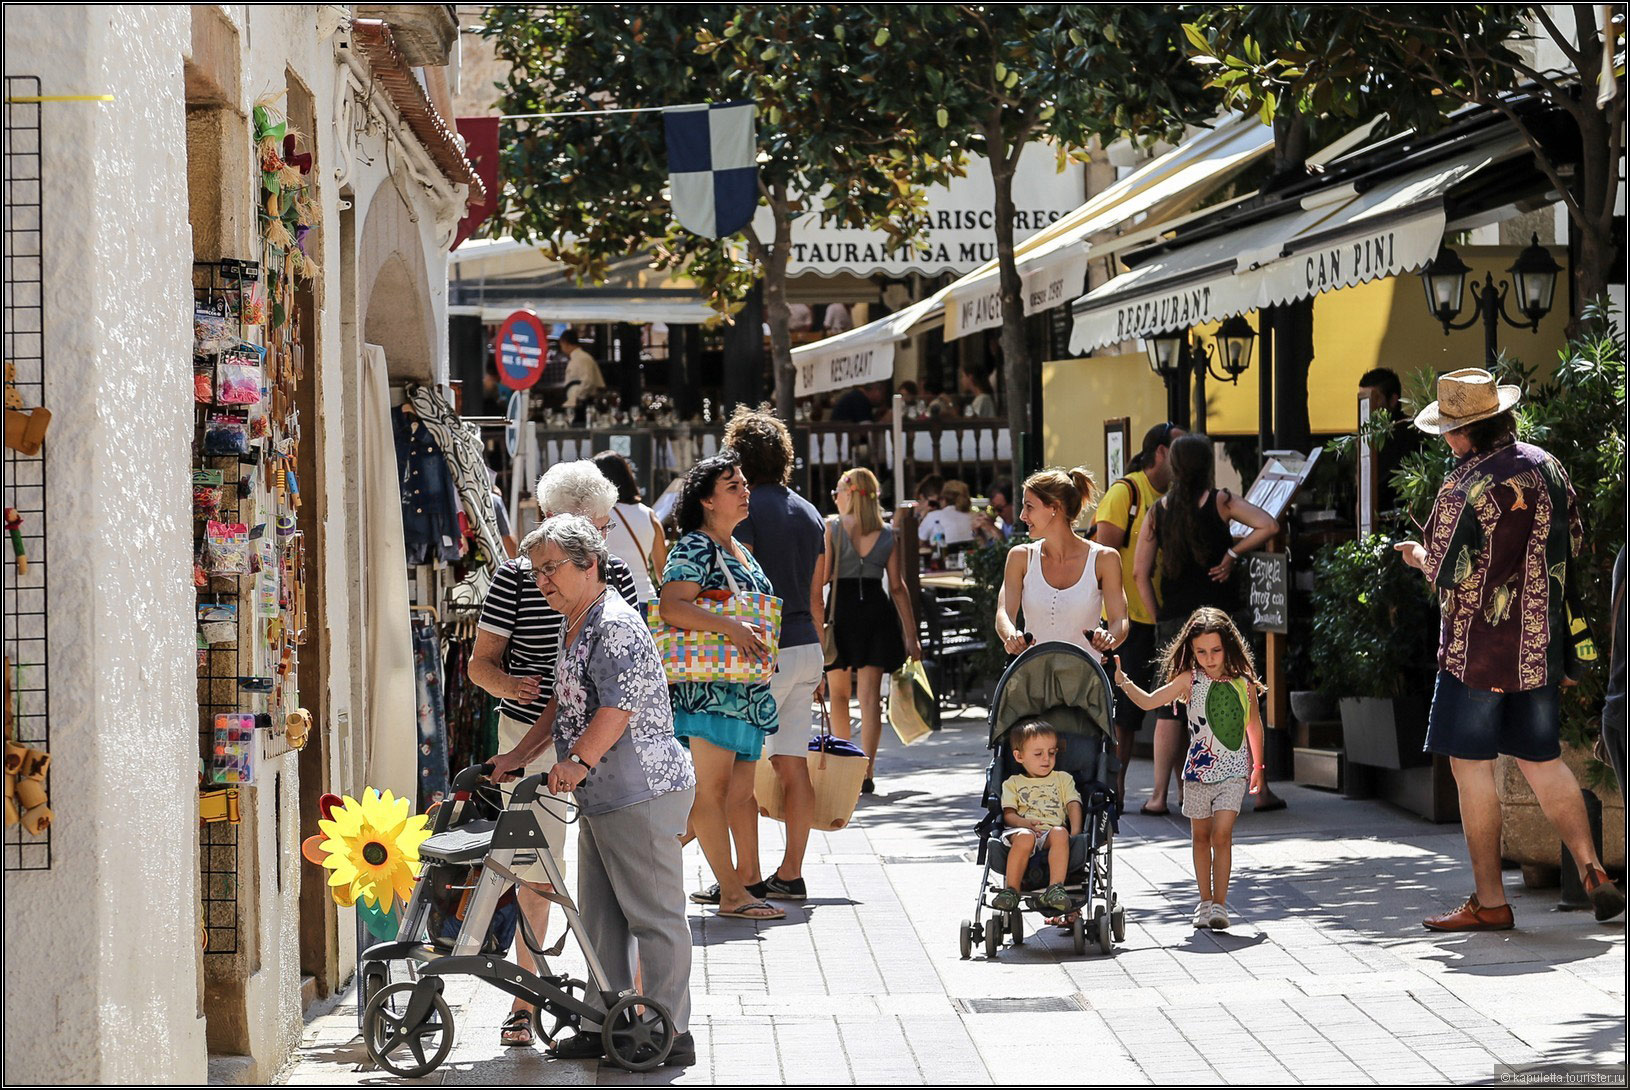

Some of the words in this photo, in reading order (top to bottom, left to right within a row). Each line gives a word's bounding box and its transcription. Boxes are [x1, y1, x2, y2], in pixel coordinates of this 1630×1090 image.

[1012, 211, 1070, 230] RES
[959, 243, 995, 262] MU
[1306, 248, 1340, 288] CAN
[1354, 232, 1395, 276] PINI
[975, 292, 1004, 324] ANGE
[1117, 287, 1211, 336] RESTAURANT
[831, 350, 873, 383] RESTAURANT
